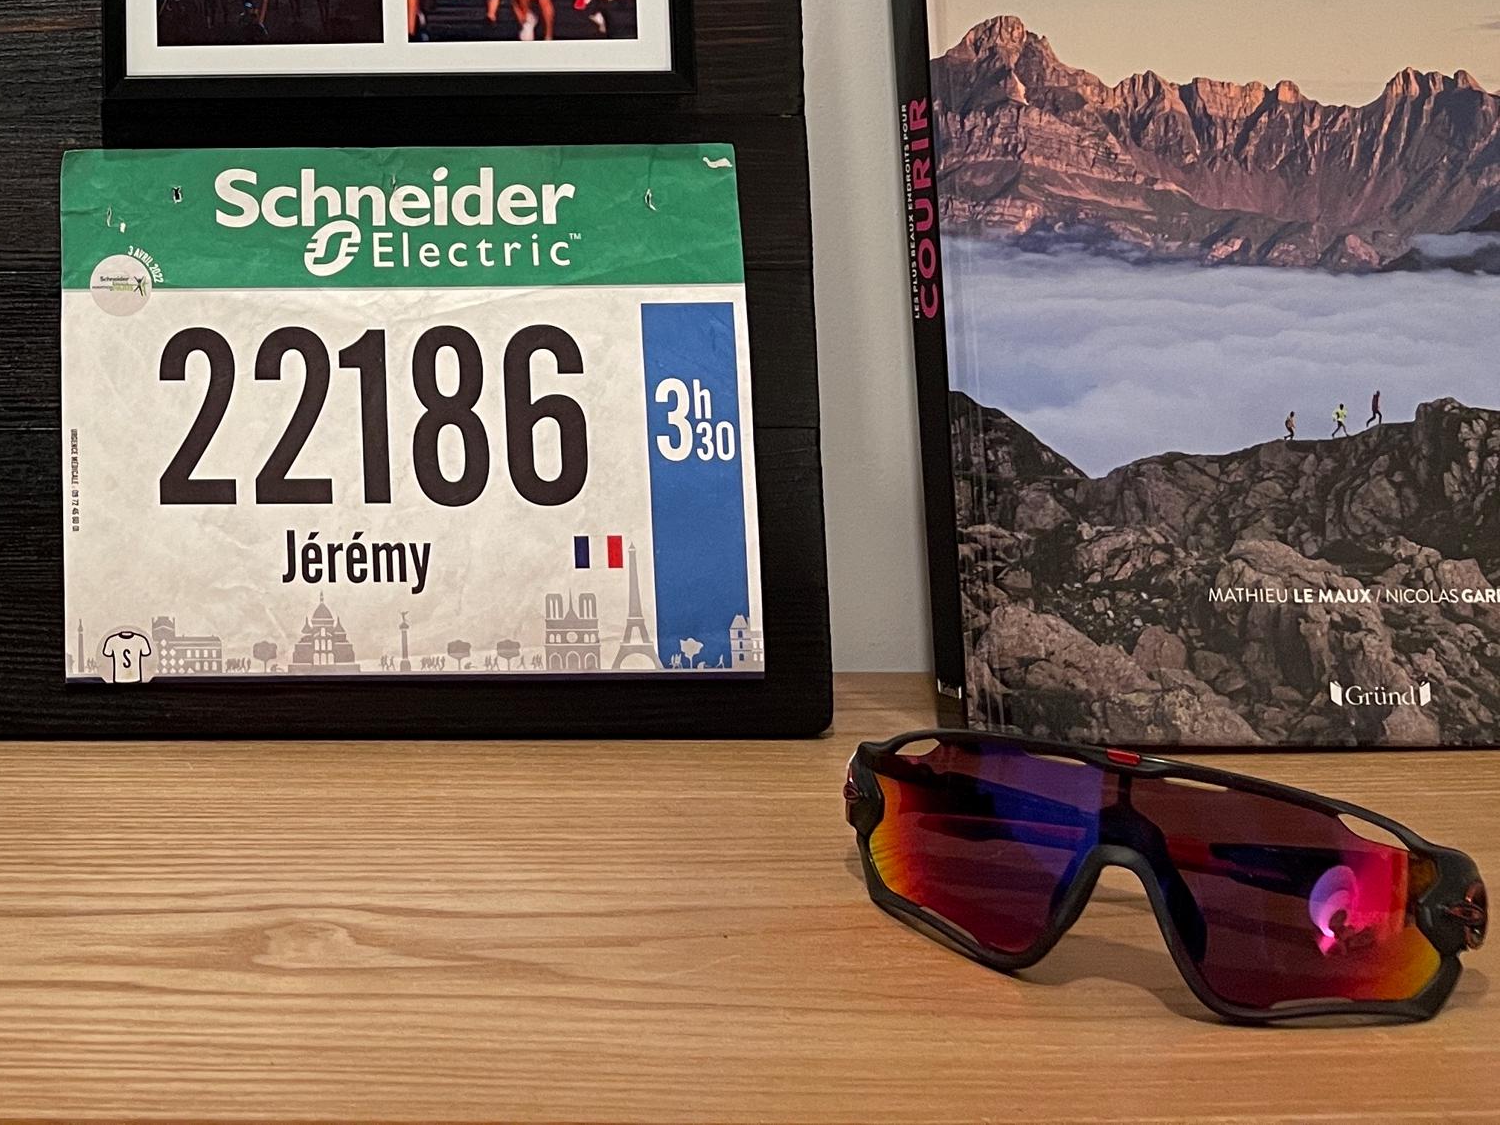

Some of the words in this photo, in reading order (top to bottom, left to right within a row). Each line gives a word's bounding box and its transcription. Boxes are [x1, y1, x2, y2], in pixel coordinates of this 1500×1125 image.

[214, 167, 576, 228] Schneider
[904, 144, 913, 210] ENDROITS
[909, 97, 938, 318] COURIR
[372, 232, 571, 268] Electric
[908, 215, 916, 257] BEAUX
[127, 245, 134, 256] 3
[133, 248, 153, 266] AVRIL
[150, 263, 164, 283] 2022
[159, 324, 589, 507] 22186
[282, 530, 431, 595] Jérémy
[1208, 587, 1288, 603] MATHIEU
[1294, 588, 1313, 603] LE
[1319, 588, 1371, 603] MAUX
[1386, 588, 1459, 603] NICOLAS
[123, 649, 131, 668] S
[1345, 685, 1417, 706] Gründ
